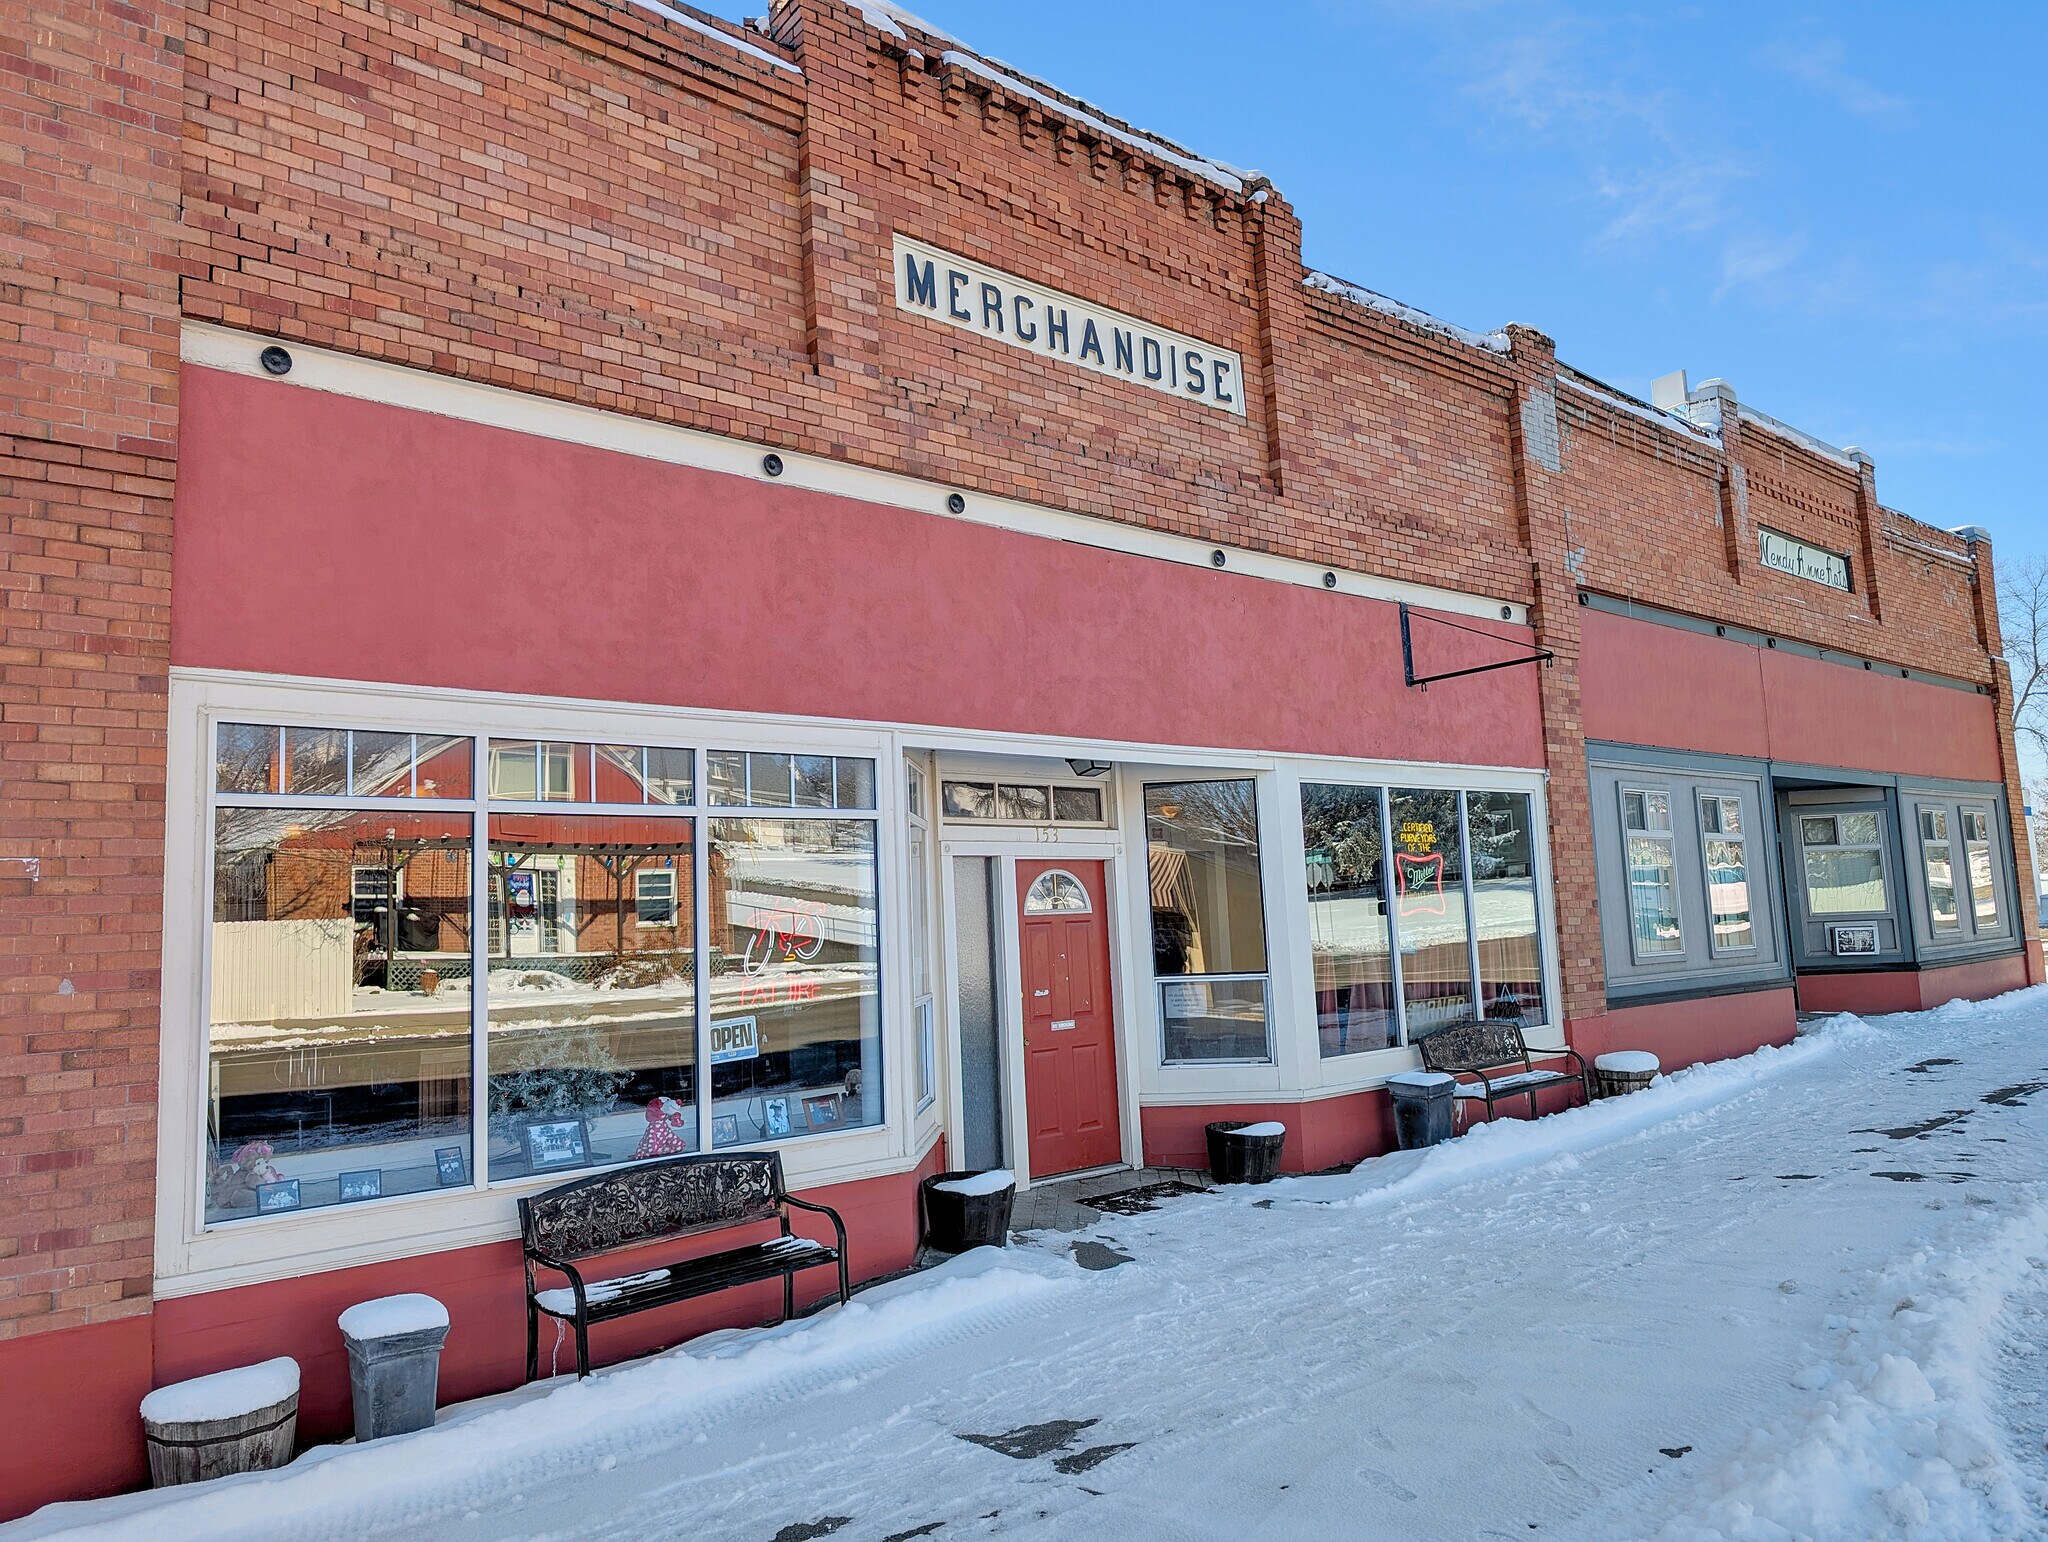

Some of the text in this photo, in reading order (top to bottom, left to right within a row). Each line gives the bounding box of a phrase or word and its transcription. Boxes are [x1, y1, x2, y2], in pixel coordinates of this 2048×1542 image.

[905, 253, 1233, 404] MERCHANDISE
[1797, 546, 1825, 581] Anne
[1036, 827, 1059, 843] 153
[1400, 833, 1437, 844] PURVEYORS
[1407, 842, 1431, 853] OF THE
[1407, 866, 1435, 888] Miller
[740, 974, 822, 1006] FAT TIRE
[710, 1023, 753, 1052] OPEN
